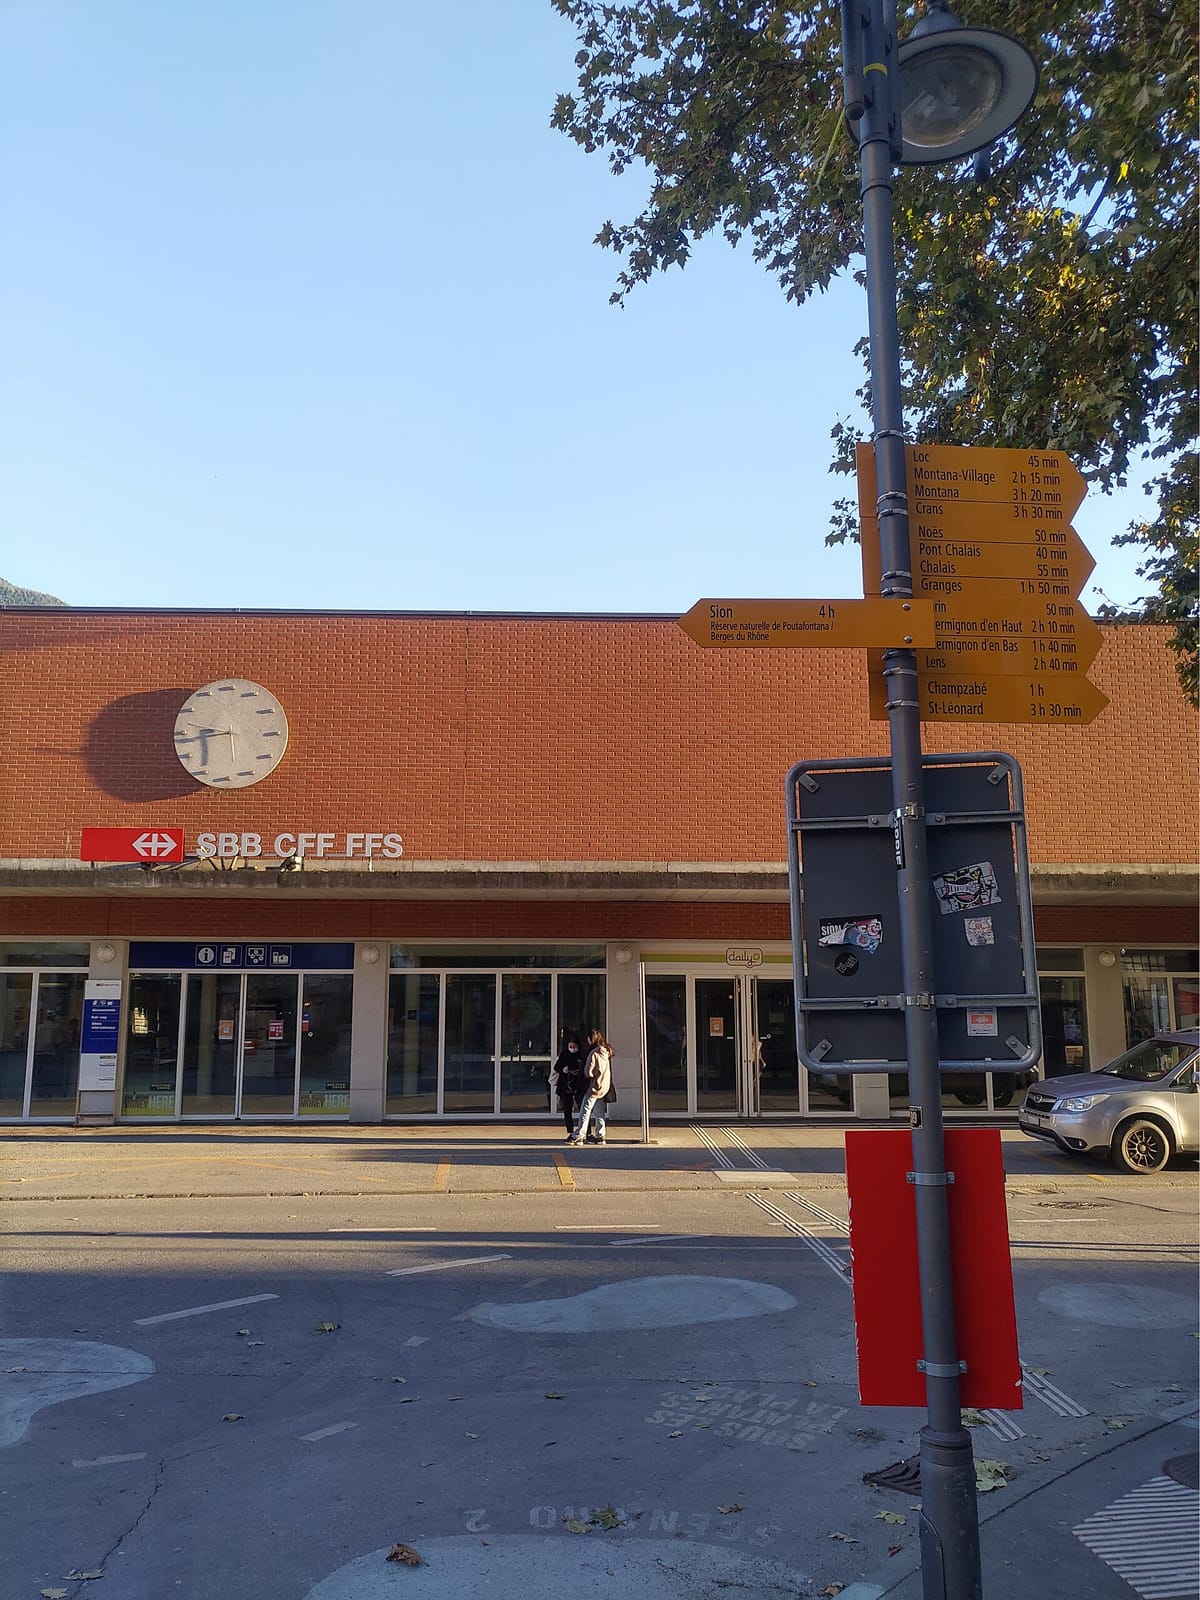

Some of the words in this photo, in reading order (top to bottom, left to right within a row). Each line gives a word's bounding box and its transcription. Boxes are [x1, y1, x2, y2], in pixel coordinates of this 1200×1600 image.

[913, 450, 930, 463] Loc
[1028, 455, 1039, 468] 45
[1042, 456, 1059, 469] min
[914, 468, 996, 486] Montana-Village
[1012, 471, 1018, 484] 2
[1020, 471, 1027, 484] h
[1031, 472, 1041, 485] 15
[1043, 473, 1060, 486] min
[915, 484, 959, 499] Montana
[1012, 488, 1019, 501] 3
[1020, 488, 1027, 501] h
[1030, 489, 1042, 502] 20
[1044, 490, 1062, 503] min
[916, 501, 944, 515] Crans
[1013, 505, 1020, 518] 3
[1021, 505, 1028, 518] h
[1031, 506, 1043, 519] 30
[1045, 507, 1063, 520] min
[918, 525, 944, 539] Noës
[1034, 529, 1047, 543] 50
[1049, 530, 1066, 543] min
[919, 542, 942, 556] Pont
[945, 543, 981, 558] Chalais
[1035, 547, 1048, 560] 40
[1050, 548, 1068, 561] min
[920, 559, 956, 574] Chalais
[1037, 564, 1049, 577] 55
[1051, 565, 1069, 578] min
[921, 577, 962, 594] Granges
[1020, 581, 1025, 593] 1
[1028, 581, 1035, 594] h
[1038, 581, 1050, 595] 50
[1052, 582, 1070, 595] min
[710, 604, 733, 618] Sion
[818, 604, 826, 618] 4
[828, 604, 835, 618] h
[934, 600, 947, 613] rin
[1045, 603, 1057, 616] 50
[1058, 603, 1074, 616] min
[740, 621, 770, 631] naturelle
[772, 621, 781, 631] de
[782, 621, 830, 631] Poutafontana
[935, 619, 978, 635] ermignon
[980, 618, 999, 632] d'en
[1001, 619, 1023, 633] Haut
[1031, 620, 1038, 633] 2
[1038, 620, 1045, 633] h
[1047, 620, 1058, 634] 10
[1060, 621, 1076, 634] min
[711, 631, 734, 643] Berges
[736, 631, 745, 641] du
[747, 631, 770, 641] Rhône
[936, 638, 979, 654] ermignon
[981, 638, 1000, 652] d'en
[1002, 639, 1018, 652] Bas
[1032, 640, 1038, 653] 1
[1039, 640, 1046, 653] h
[1048, 640, 1059, 653] 40
[1061, 641, 1077, 654] min
[925, 655, 946, 669] Lens
[1033, 657, 1039, 671] 2
[1040, 657, 1047, 671] h
[1049, 658, 1060, 671] 40
[1062, 658, 1078, 672] min
[928, 680, 987, 698] Champzabé
[1029, 683, 1035, 696] 1
[1038, 683, 1044, 696] h
[928, 701, 984, 715] St-Léonard
[1030, 703, 1037, 716] 3
[1039, 703, 1046, 717] h
[1050, 703, 1061, 717] 30
[1064, 704, 1082, 718] min
[196, 832, 262, 858] SBB
[274, 832, 336, 858] CFF
[346, 832, 404, 858] FFS
[728, 950, 755, 967] daily
[644, 1409, 713, 1430] ES
[464, 1508, 490, 1532] 2
